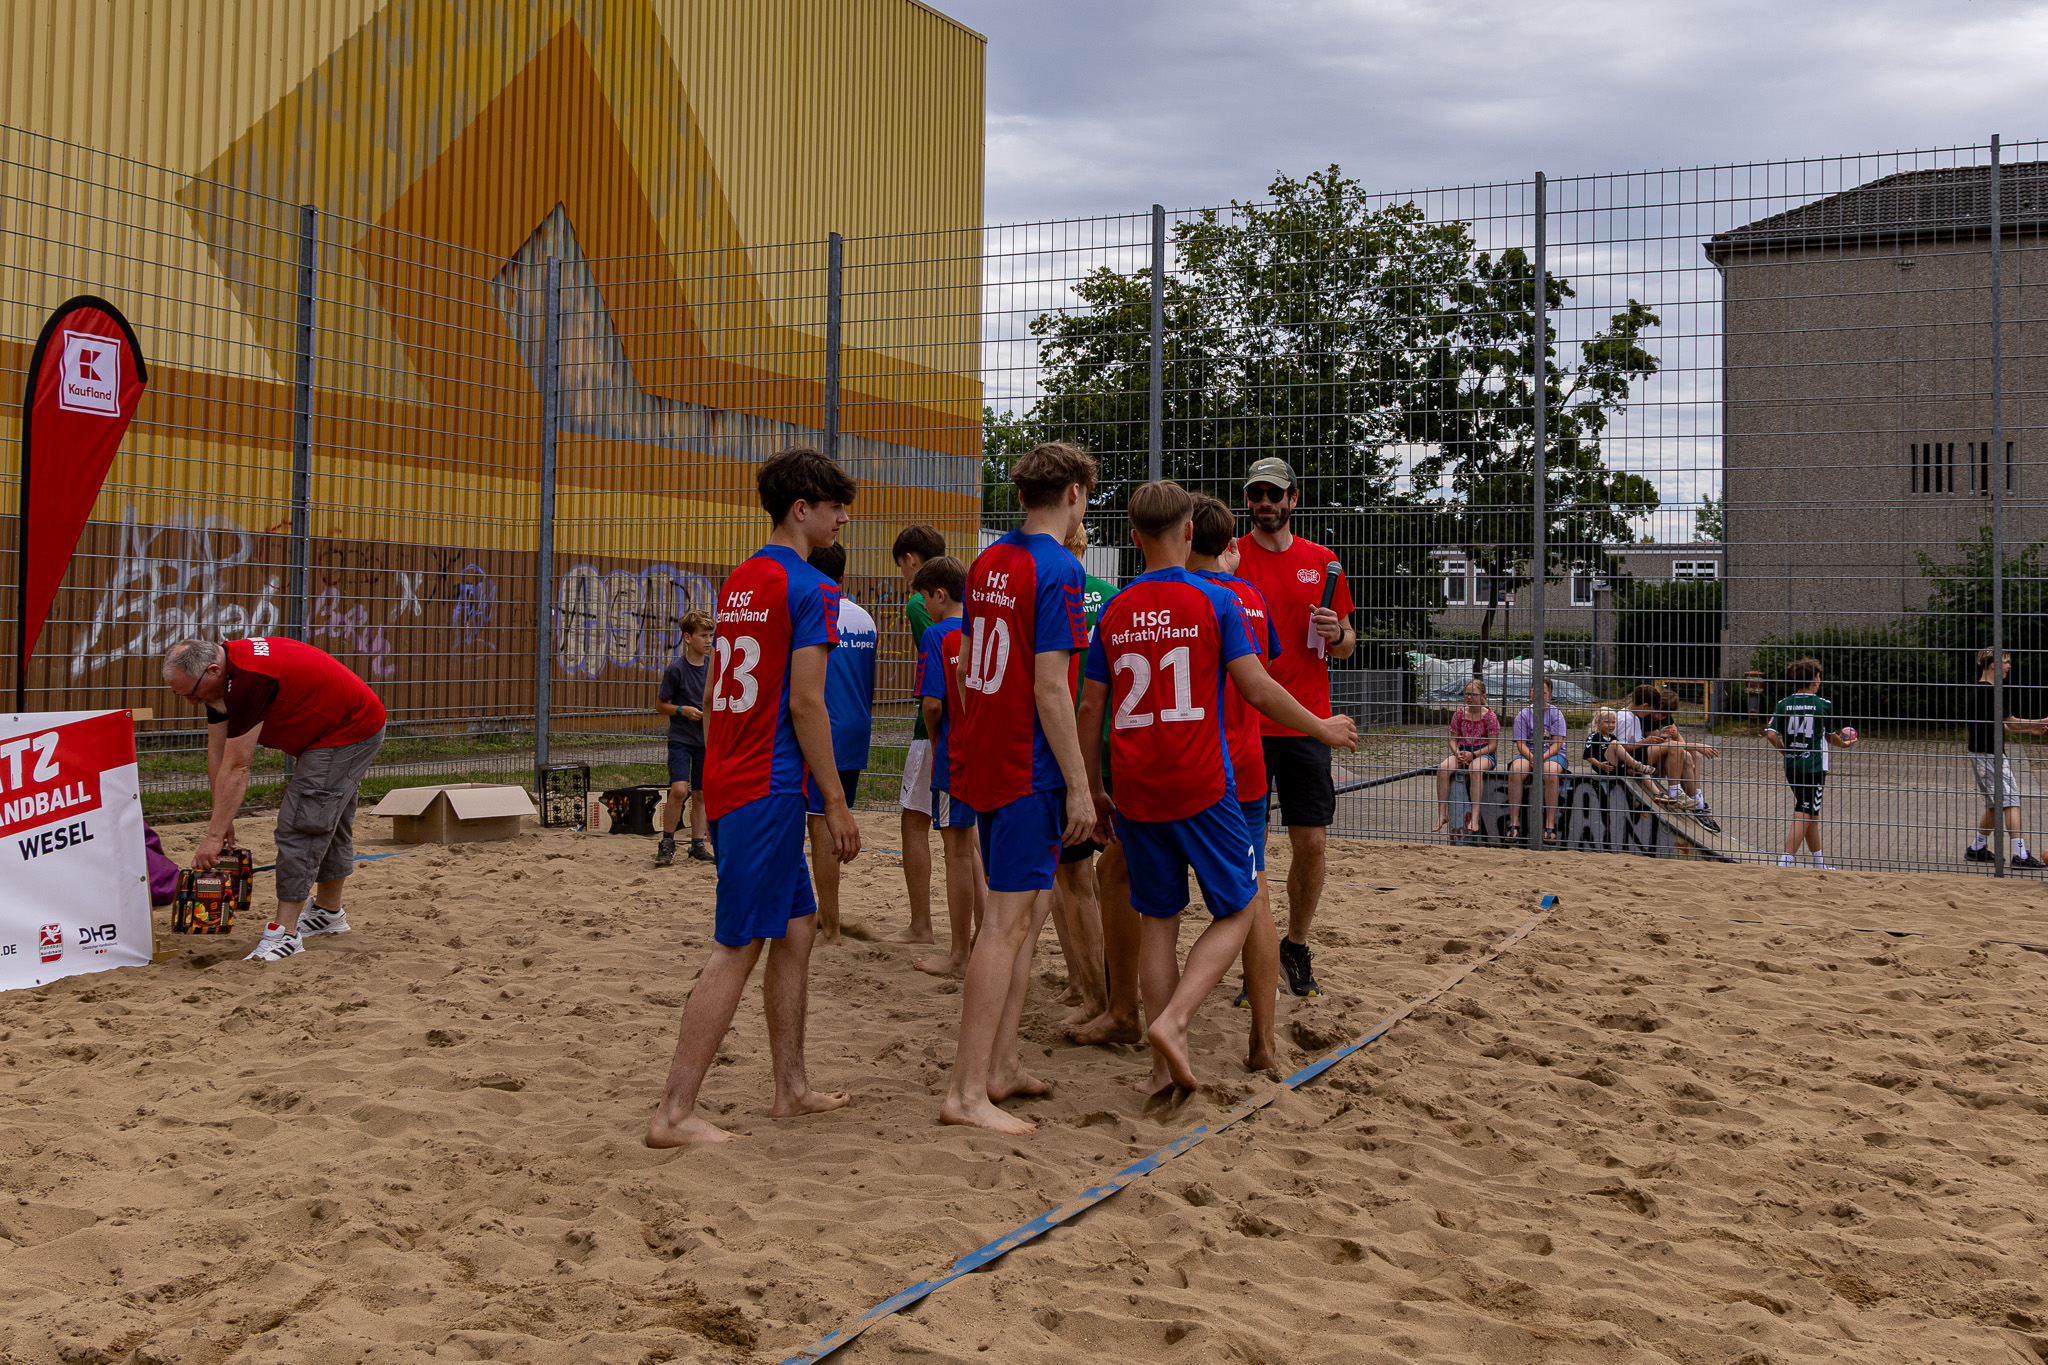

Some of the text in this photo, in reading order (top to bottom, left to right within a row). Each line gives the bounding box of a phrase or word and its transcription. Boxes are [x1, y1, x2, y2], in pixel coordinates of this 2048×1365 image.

[68, 383, 112, 401] Kaufland
[726, 590, 754, 608] HSG
[1083, 591, 1102, 604] SG
[1133, 609, 1171, 628] HSG
[850, 639, 875, 650] Lopez
[1111, 625, 1199, 646] Refrath/Hand
[965, 617, 1010, 694] 10
[713, 636, 761, 713] 23
[1114, 647, 1205, 729] 21
[1787, 714, 1814, 738] 44
[0, 731, 59, 793] TZ
[18, 820, 95, 861] WESEL
[79, 923, 116, 945] DHB
